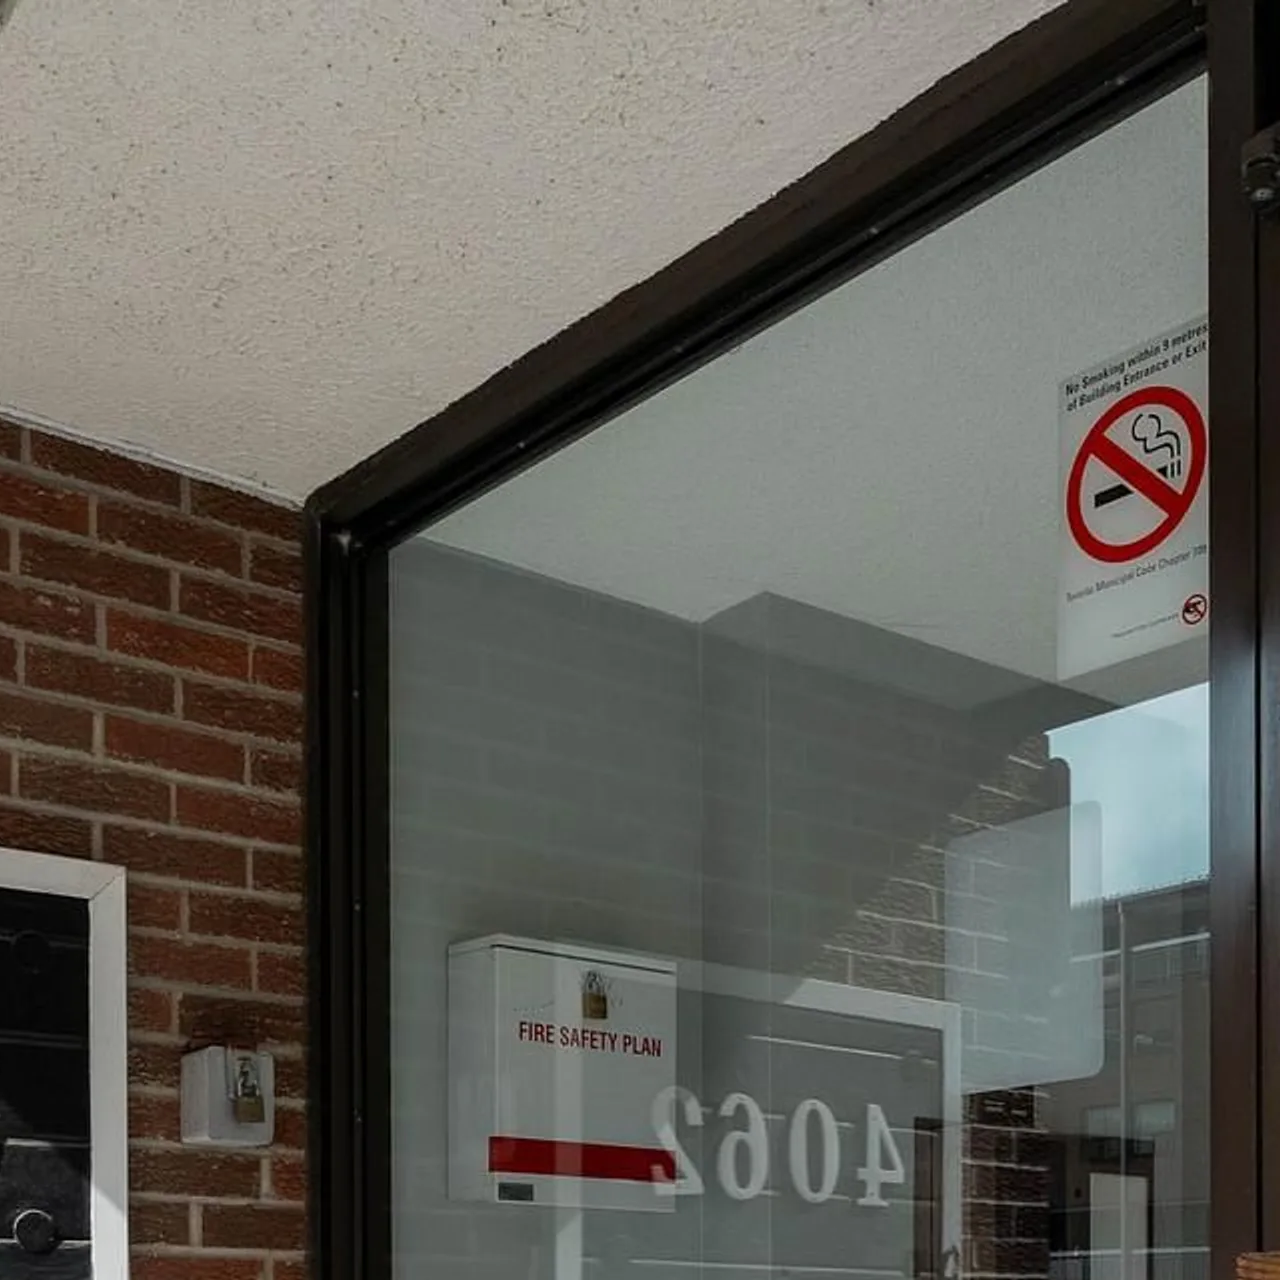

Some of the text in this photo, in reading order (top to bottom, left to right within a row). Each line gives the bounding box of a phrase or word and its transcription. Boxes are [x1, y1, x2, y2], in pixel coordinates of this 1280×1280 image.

[1065, 322, 1208, 397] No Smoking within 9 metres
[1066, 340, 1207, 412] of Building Entrance or Exit
[1136, 562, 1157, 578] Code
[1158, 550, 1191, 569] Chapter
[518, 1020, 662, 1058] FIRE SAFETY PLAN
